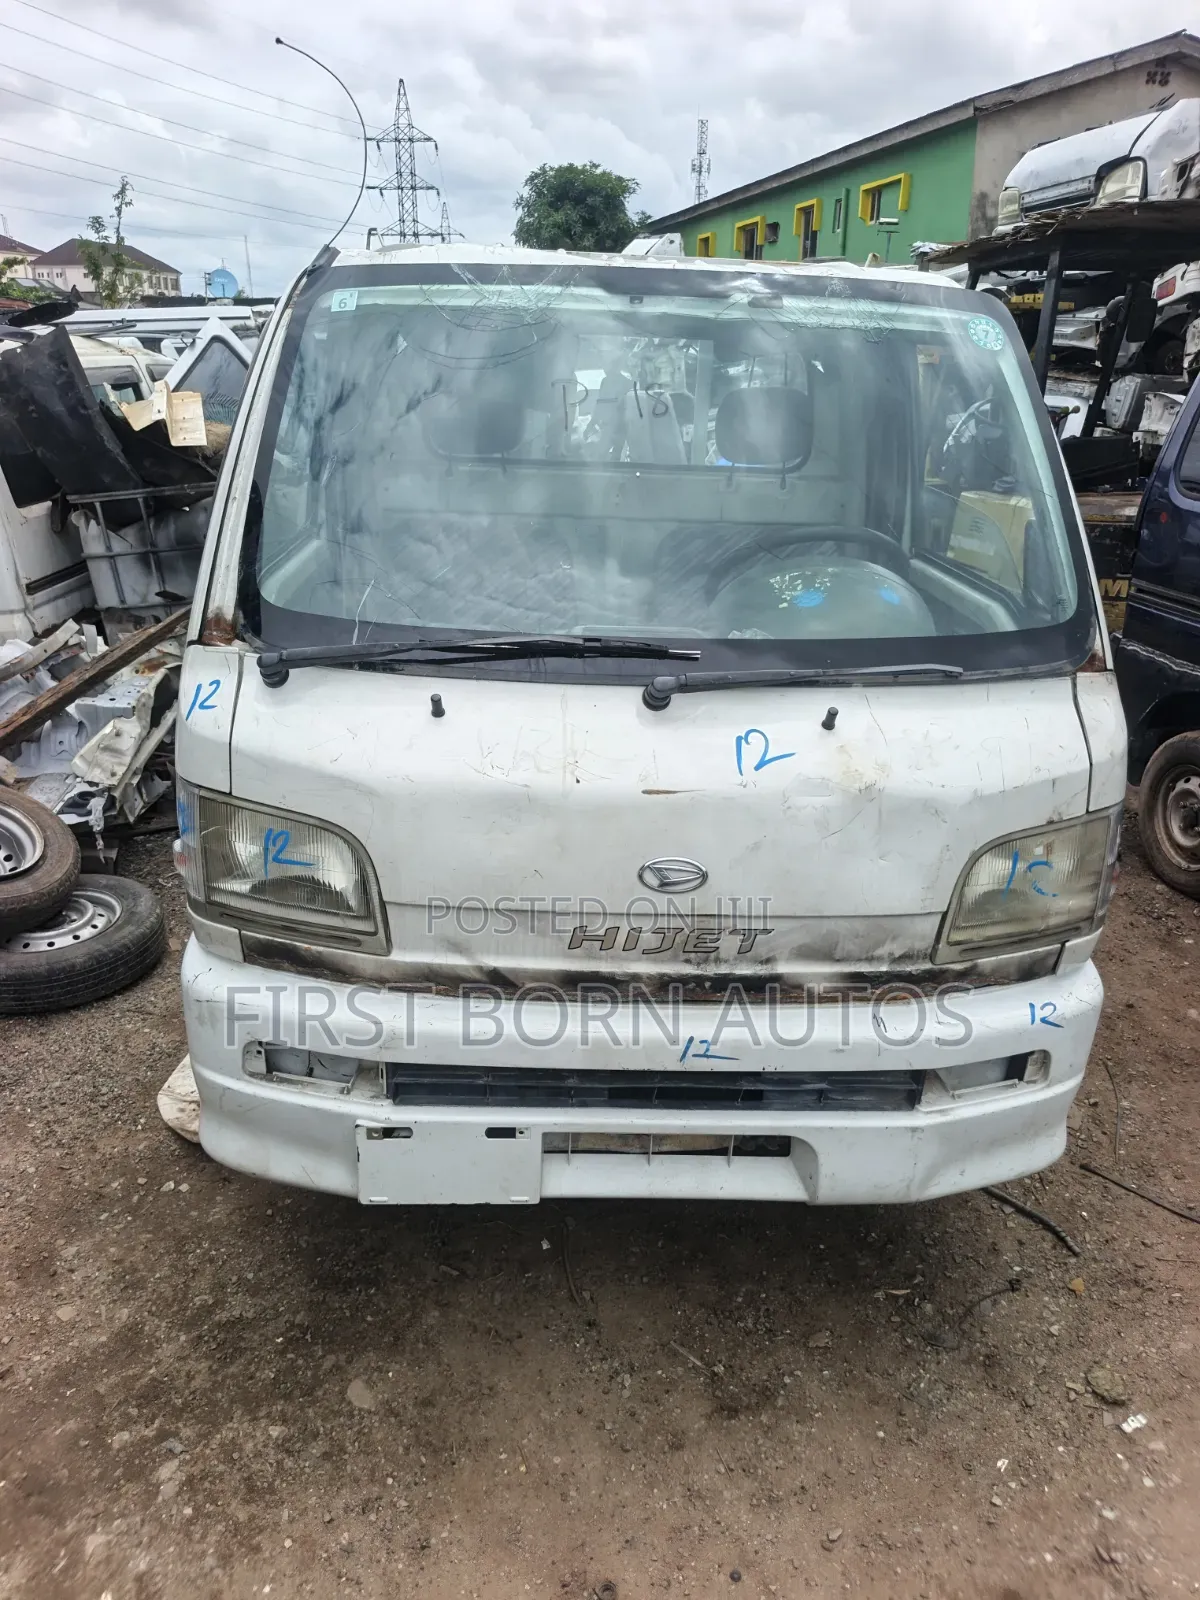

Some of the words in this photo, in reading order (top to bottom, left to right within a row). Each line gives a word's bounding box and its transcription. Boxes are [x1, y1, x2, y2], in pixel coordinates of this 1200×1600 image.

[338, 297, 348, 310] 6
[185, 679, 222, 722] 12
[735, 728, 798, 777] 12
[263, 827, 317, 880] 12
[567, 924, 775, 956] HIJET
[1028, 1001, 1065, 1029] 12
[679, 1035, 741, 1064] 12
